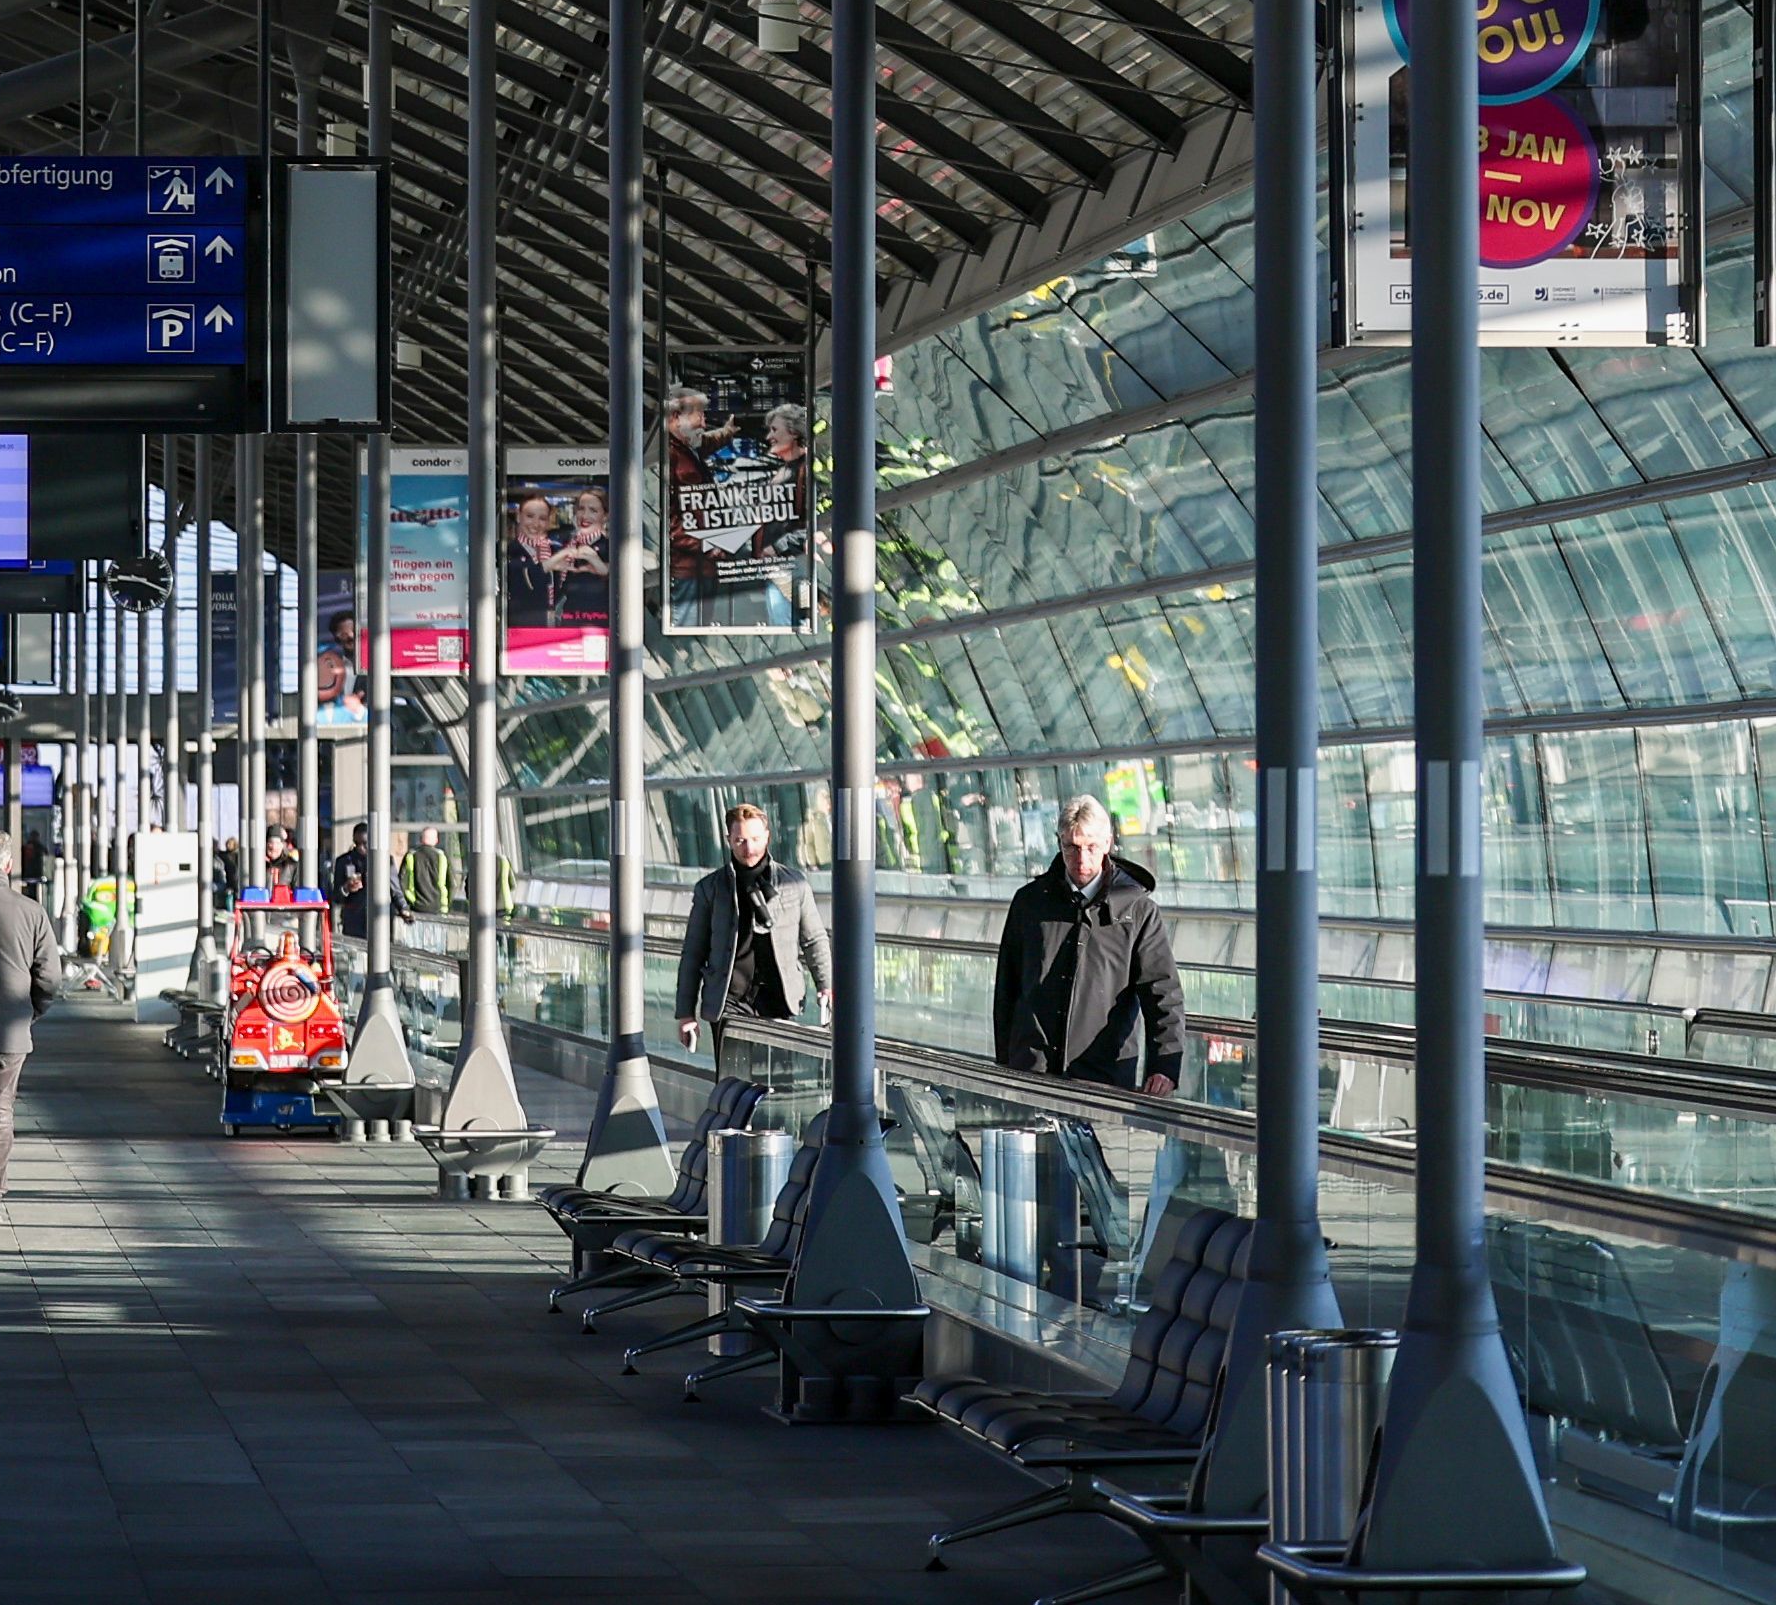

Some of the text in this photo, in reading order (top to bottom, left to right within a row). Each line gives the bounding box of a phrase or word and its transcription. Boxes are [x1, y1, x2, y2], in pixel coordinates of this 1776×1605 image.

[1478, 8, 1564, 64] OU!
[1500, 130, 1566, 165] JAN
[1486, 195, 1565, 232] NOV
[412, 457, 452, 467] condor
[558, 457, 597, 467] condor
[680, 483, 797, 511] FRANKFURT
[682, 502, 800, 530] & ISTANBUL
[392, 559, 453, 571] fliegen ein
[419, 572, 454, 583] gegen
